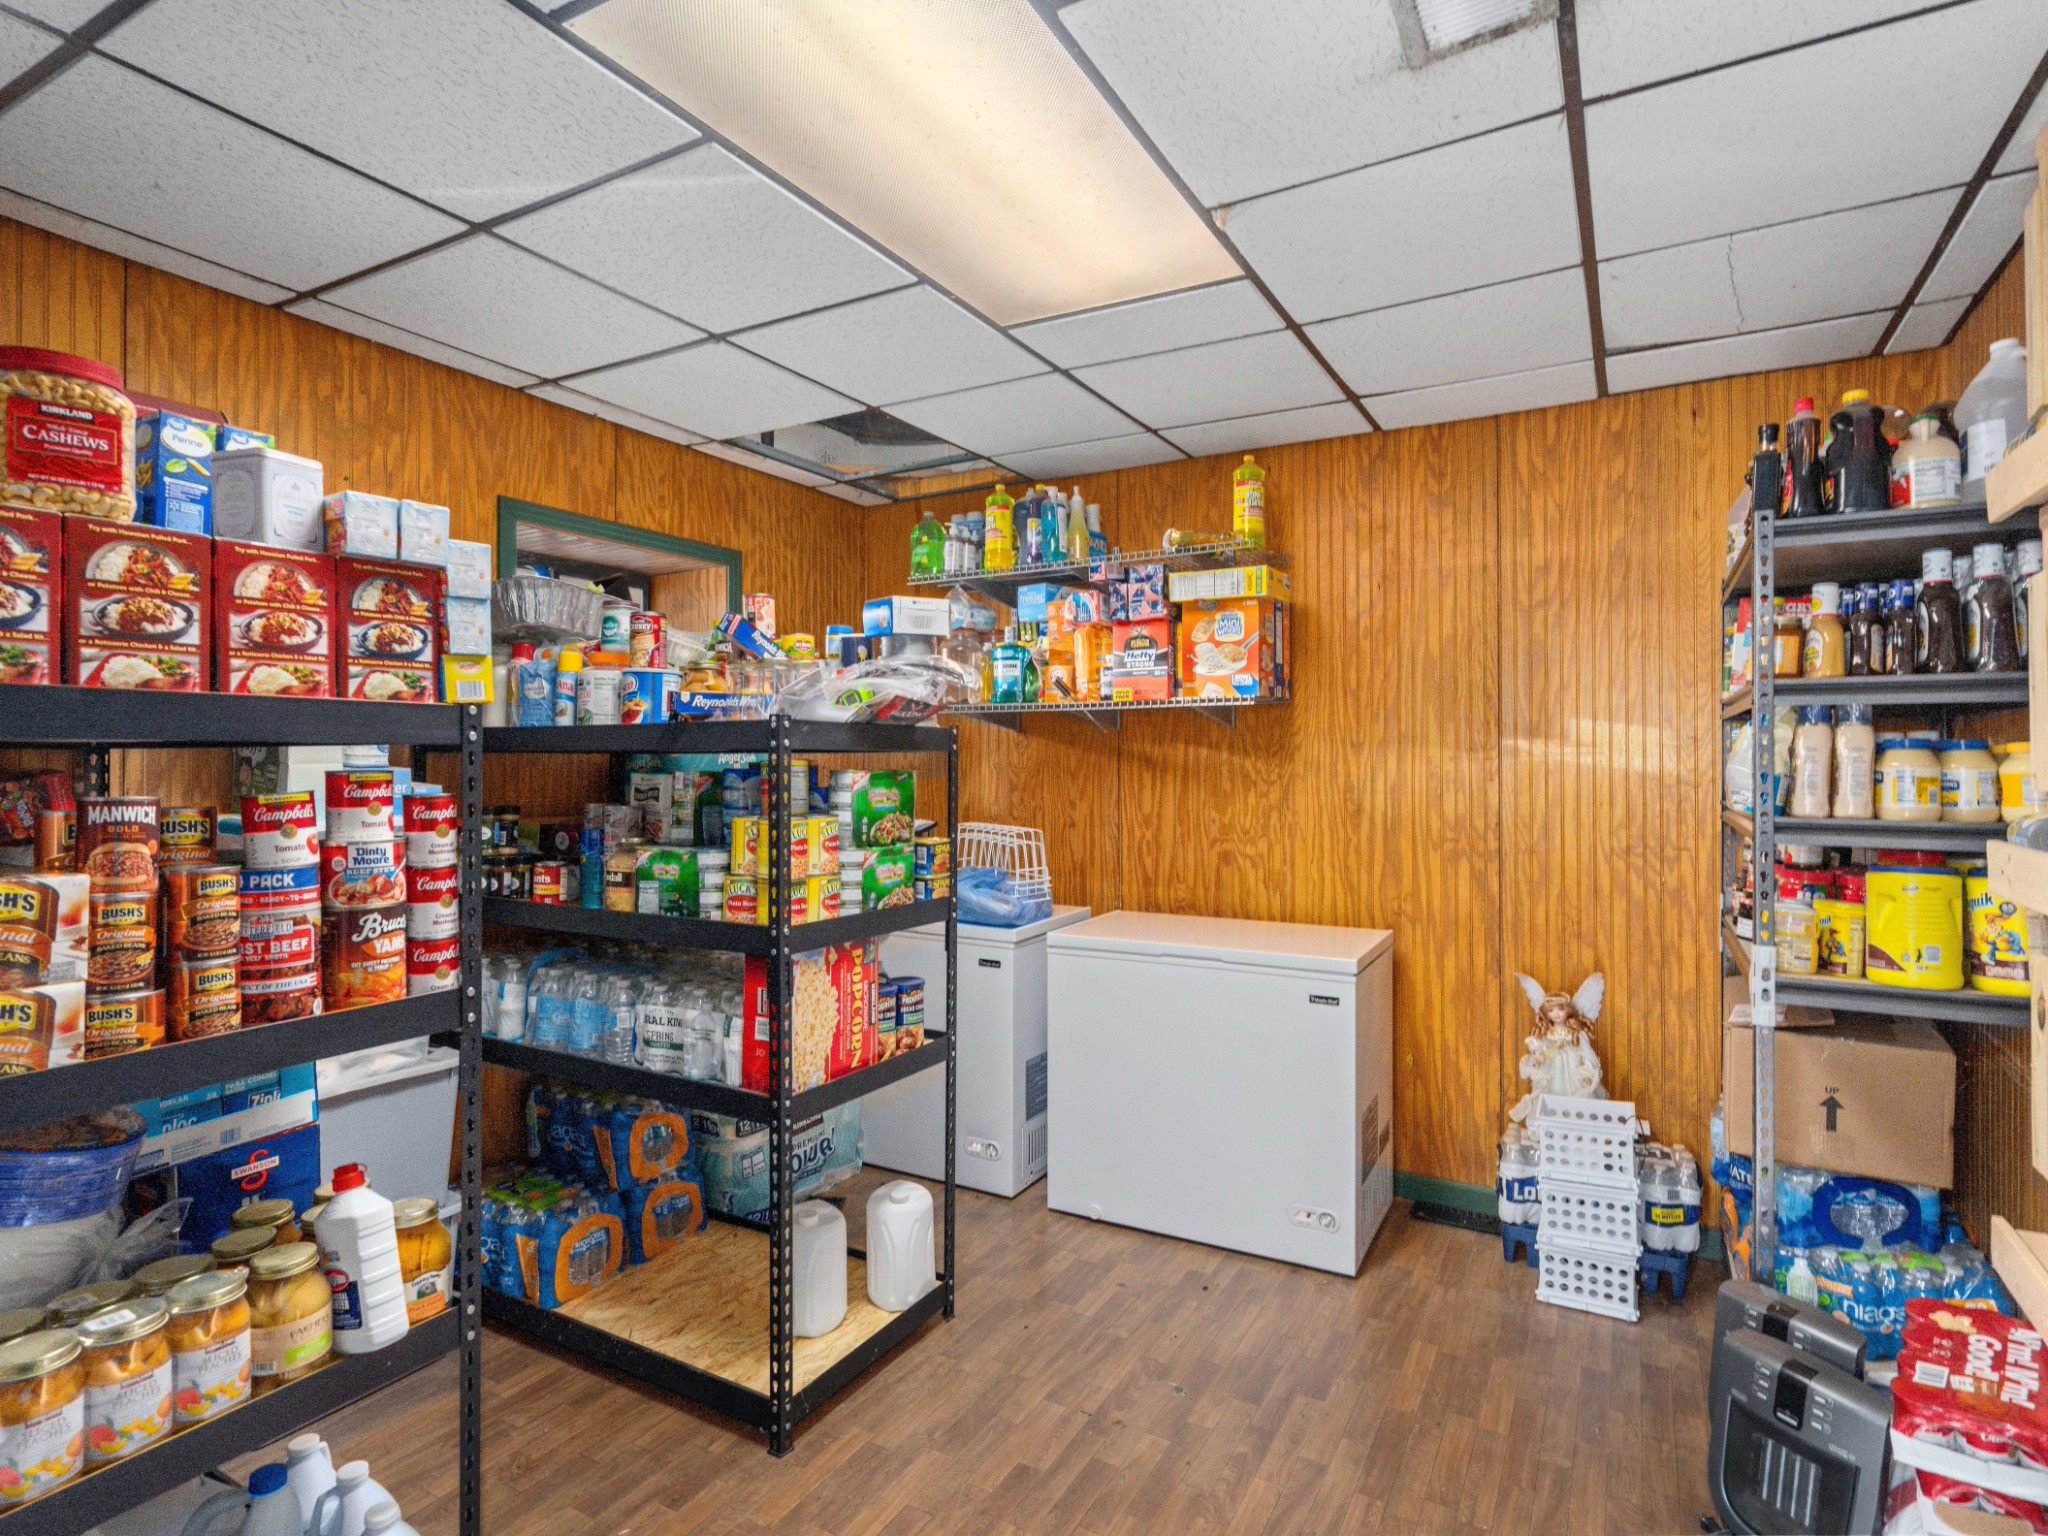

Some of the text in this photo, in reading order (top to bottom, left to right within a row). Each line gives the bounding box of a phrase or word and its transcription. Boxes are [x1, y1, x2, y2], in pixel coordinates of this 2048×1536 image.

[41, 405, 93, 420] KIRKLAND
[23, 425, 109, 452] CASHEWS
[173, 433, 203, 448] Penne
[1127, 652, 1154, 661] Hefty
[692, 694, 739, 710] Reynolds
[718, 753, 741, 765] Angel
[88, 806, 157, 826] MANWICH
[274, 844, 305, 853] Tomato
[355, 848, 387, 858] Dinty
[352, 856, 389, 866] Moore
[346, 867, 371, 875] BEEF
[200, 877, 235, 891] BUSH'S
[249, 873, 295, 889] PACK
[196, 899, 237, 912] Original
[101, 906, 144, 920] BUSH'S
[97, 928, 146, 940] Original
[97, 941, 146, 952] BAKED BEANS
[270, 937, 309, 954] BEEF
[198, 970, 234, 986] BUSH'S
[275, 980, 292, 988] THE
[195, 991, 237, 1006] Original
[88, 1008, 133, 1022] BUSH'S
[851, 948, 863, 1068] POPCORN
[85, 1025, 137, 1039] Original
[647, 1030, 674, 1042] SPRING
[1825, 1085, 1839, 1094] UP
[233, 1159, 278, 1179] SWANSON
